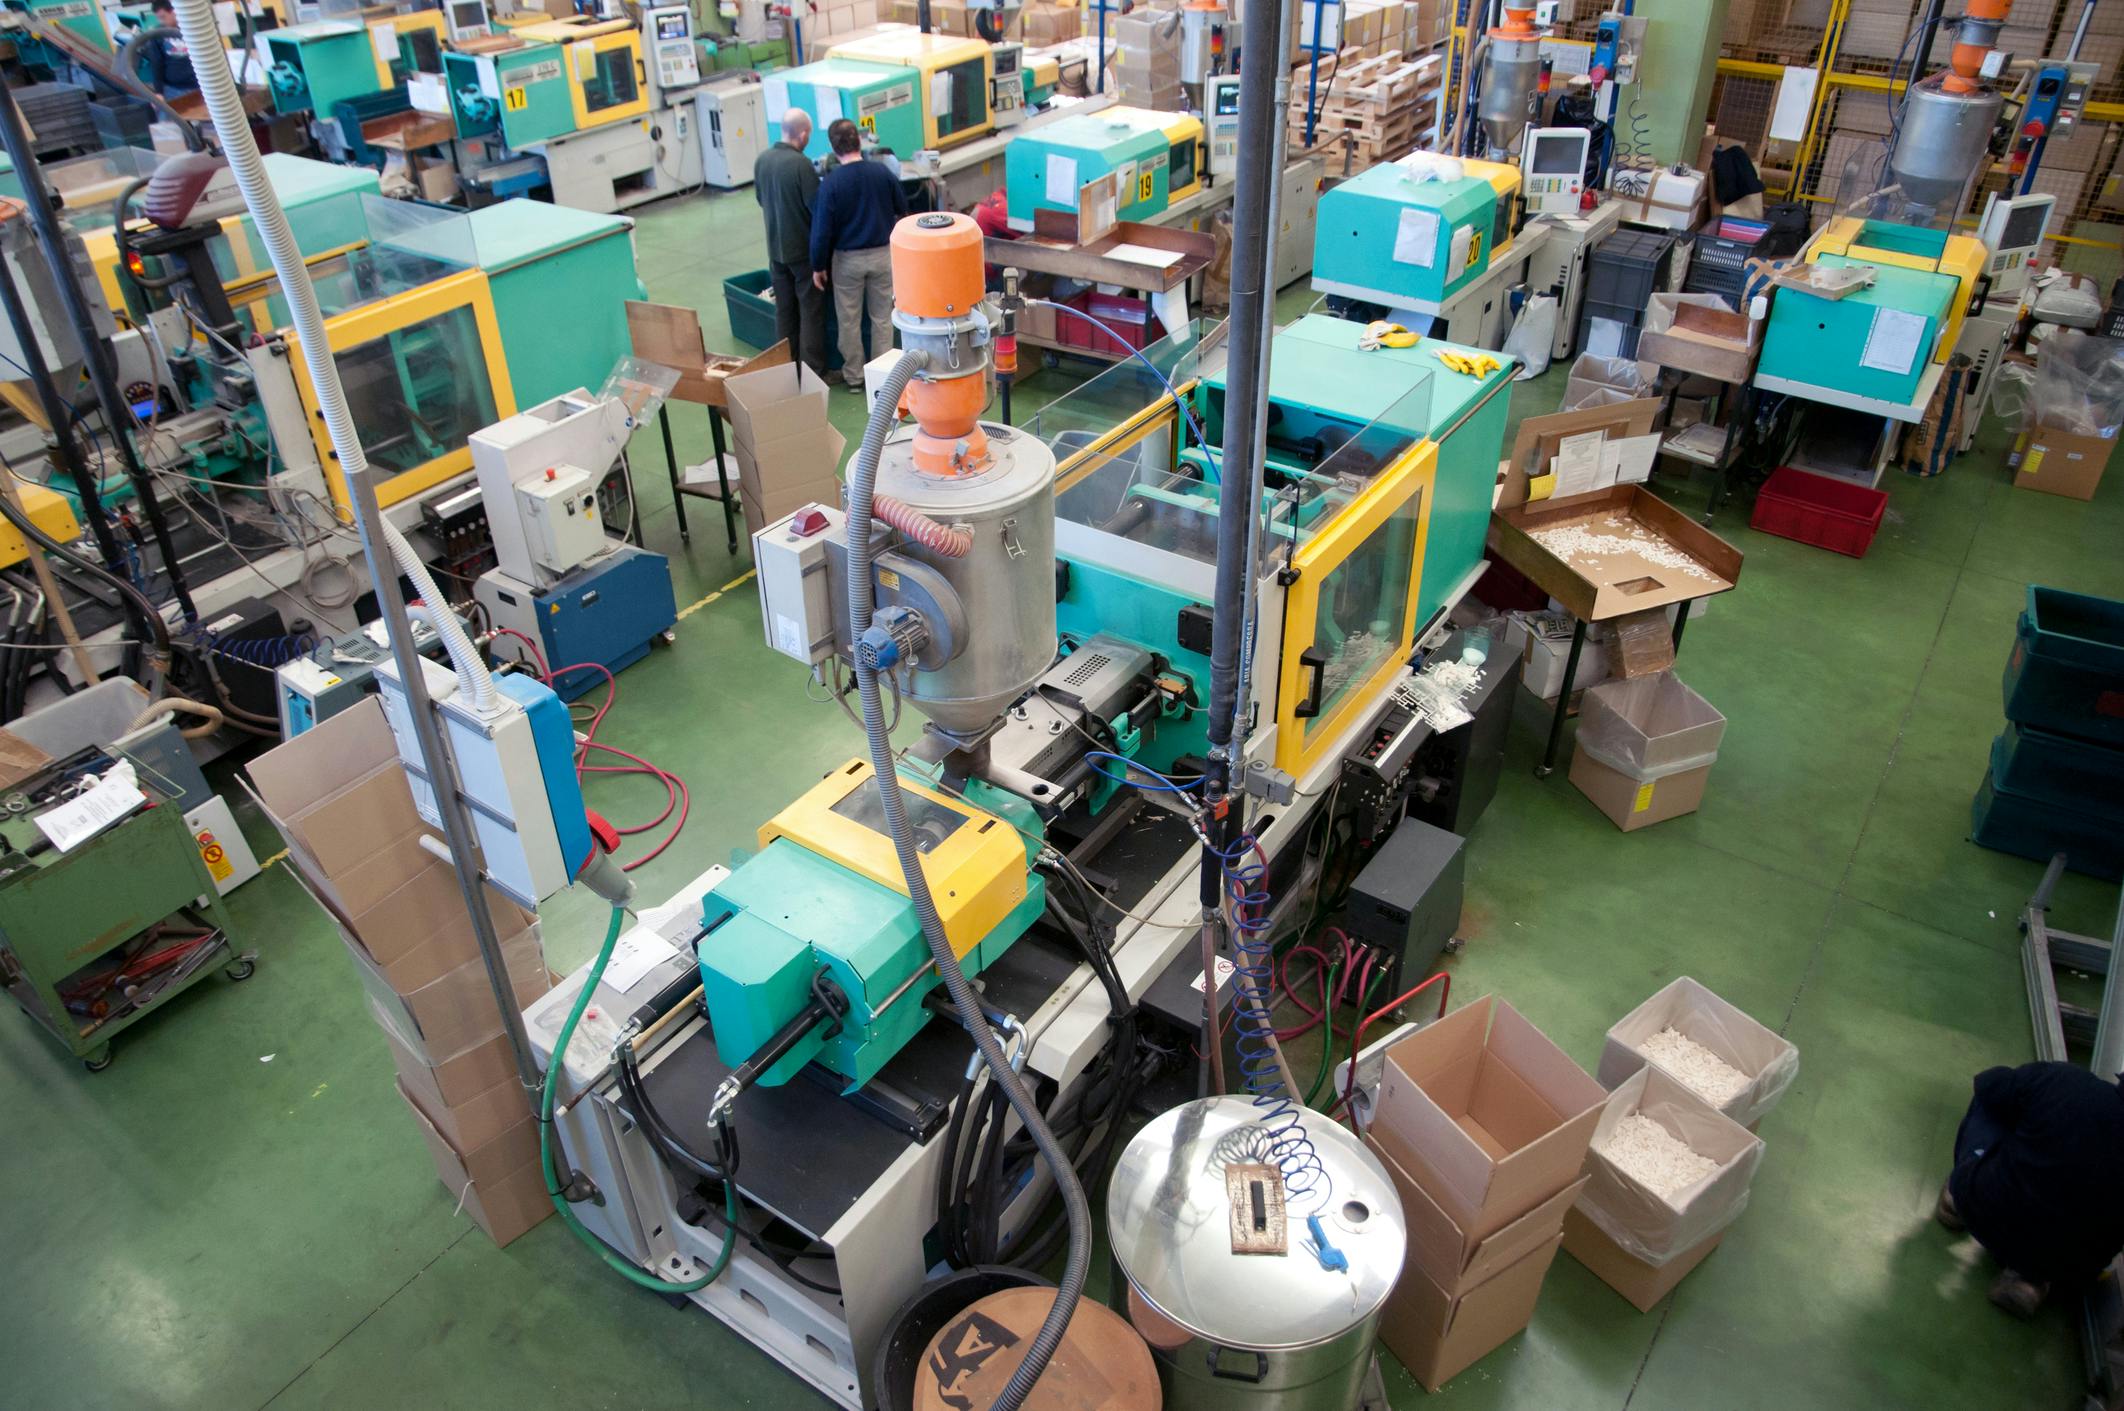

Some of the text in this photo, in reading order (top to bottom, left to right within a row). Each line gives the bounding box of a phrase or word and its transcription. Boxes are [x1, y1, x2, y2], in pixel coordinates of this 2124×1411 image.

[507, 88, 523, 109] 17
[1140, 174, 1152, 199] 19
[1467, 235, 1481, 265] 20
